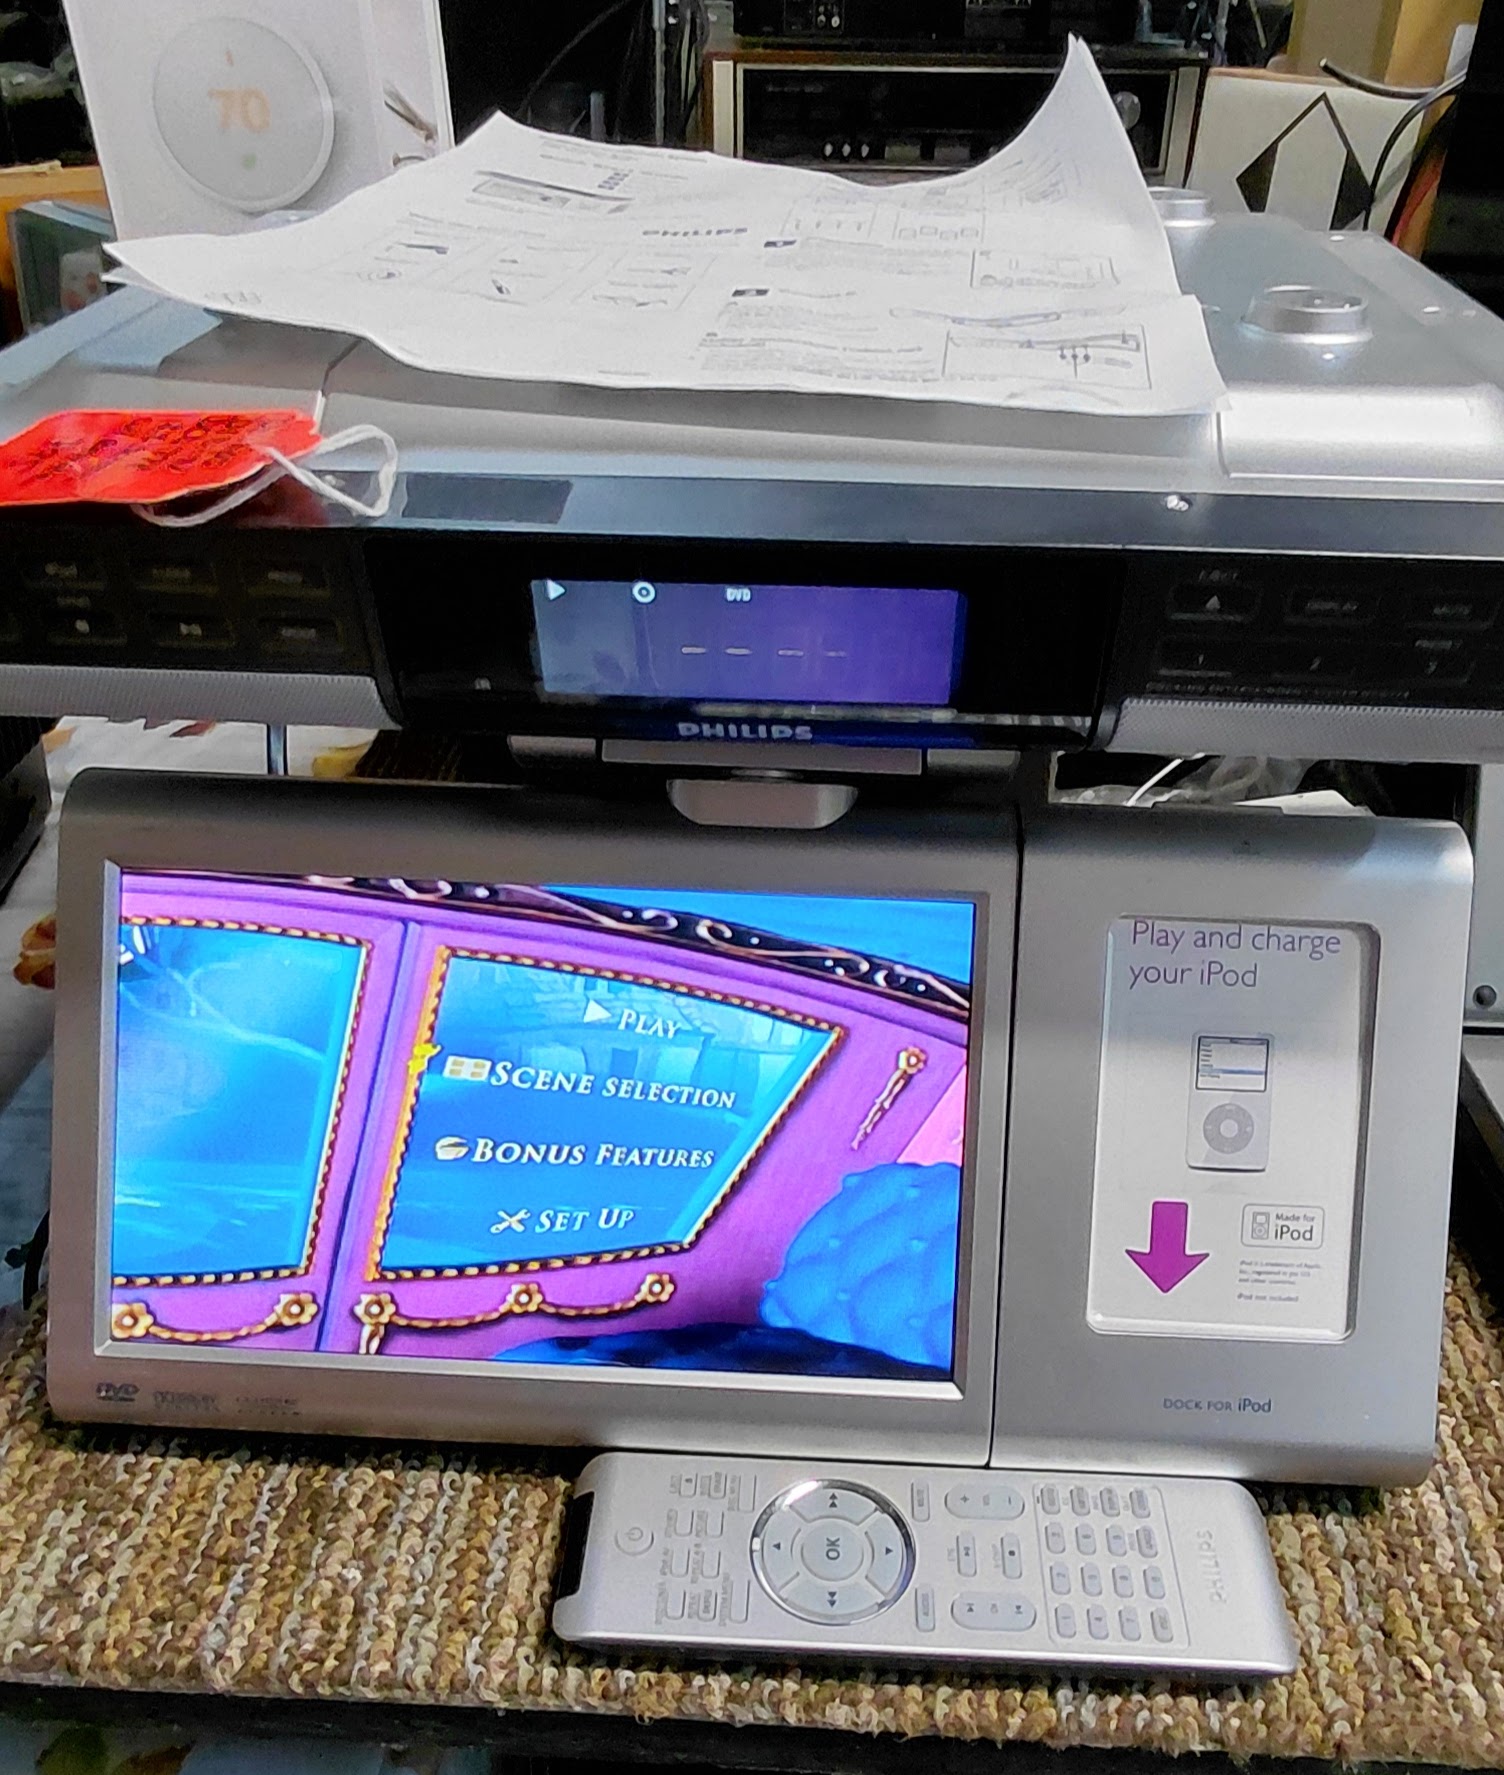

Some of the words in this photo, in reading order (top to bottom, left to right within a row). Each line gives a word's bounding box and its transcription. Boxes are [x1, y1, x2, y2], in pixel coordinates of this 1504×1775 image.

[207, 88, 272, 133] 70
[726, 587, 751, 602] DVD
[677, 722, 813, 740] PHILIPS
[1132, 919, 1185, 955] Play
[1193, 923, 1242, 949] and
[1251, 926, 1341, 961] charge
[1129, 965, 1192, 990] your
[1200, 959, 1257, 988] iPod
[618, 1008, 682, 1039] PLAY
[490, 1061, 596, 1096] SCENE
[602, 1077, 736, 1109] SELECTION
[471, 1137, 585, 1166] BONUS
[594, 1143, 714, 1168] FEATURES
[534, 1209, 589, 1233] SET
[597, 1208, 634, 1230] UP
[1275, 1213, 1301, 1222] Made
[1275, 1224, 1314, 1241] iPod
[1163, 1398, 1203, 1410] DOCK
[1207, 1400, 1232, 1411] FOR
[1238, 1398, 1272, 1413] iPod
[826, 1537, 841, 1561] OK
